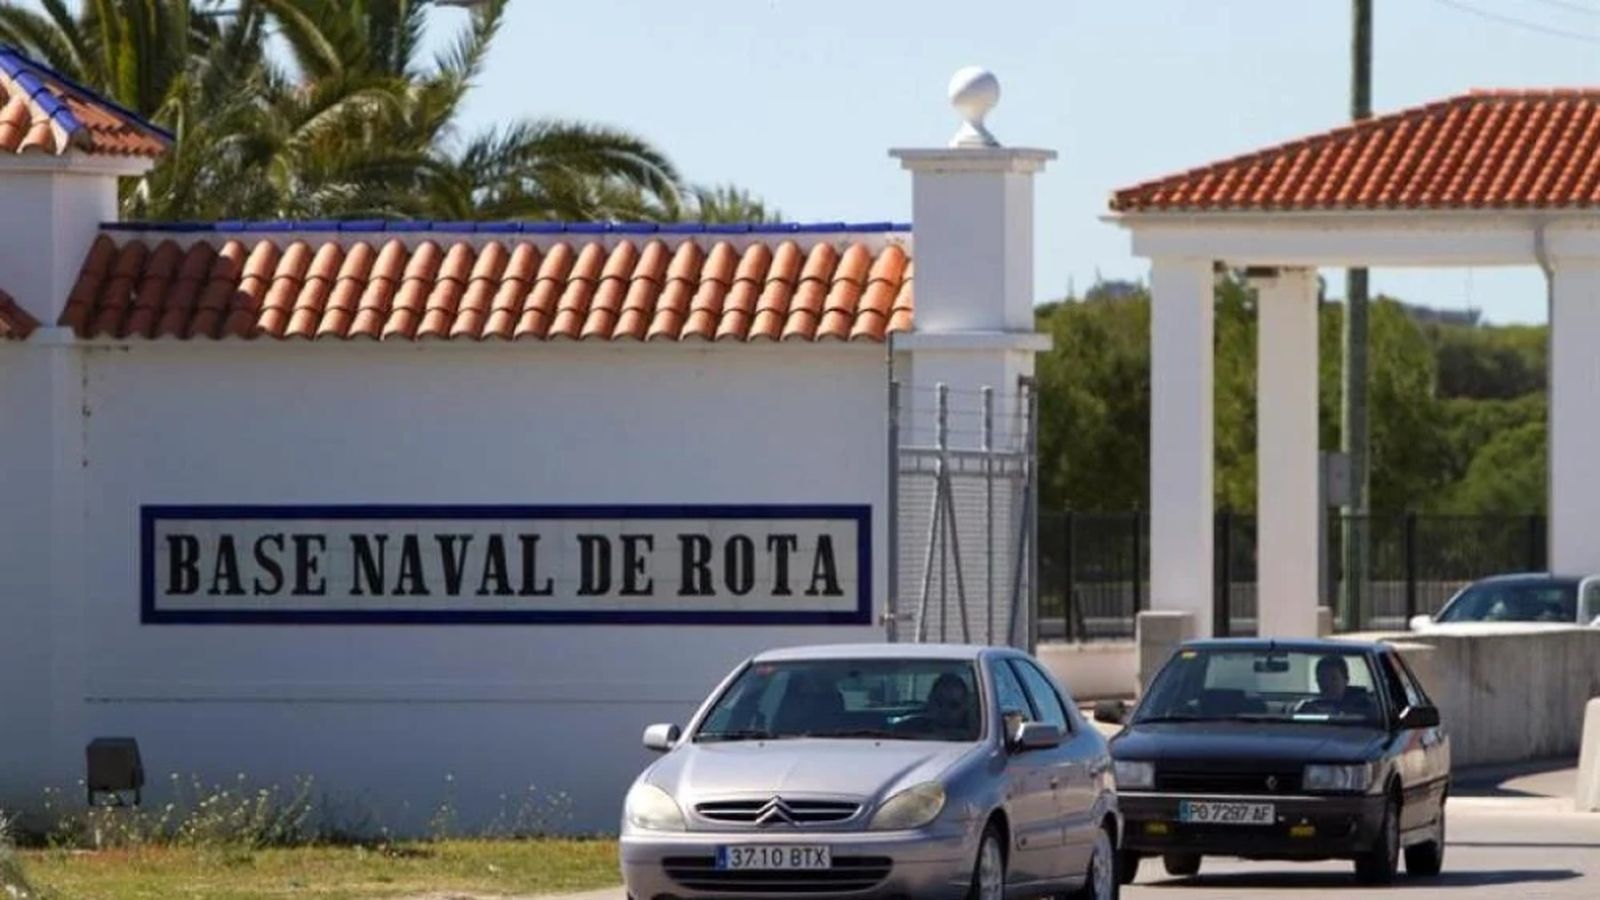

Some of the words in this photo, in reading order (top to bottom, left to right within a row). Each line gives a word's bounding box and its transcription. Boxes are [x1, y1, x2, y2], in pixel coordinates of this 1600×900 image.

[165, 533, 328, 596] BASE
[349, 533, 555, 597] NAVAL
[576, 533, 655, 597] DE
[677, 533, 845, 597] ROTA
[1212, 804, 1249, 821] 7297
[731, 847, 783, 867] 3710
[790, 847, 826, 867] BTX
